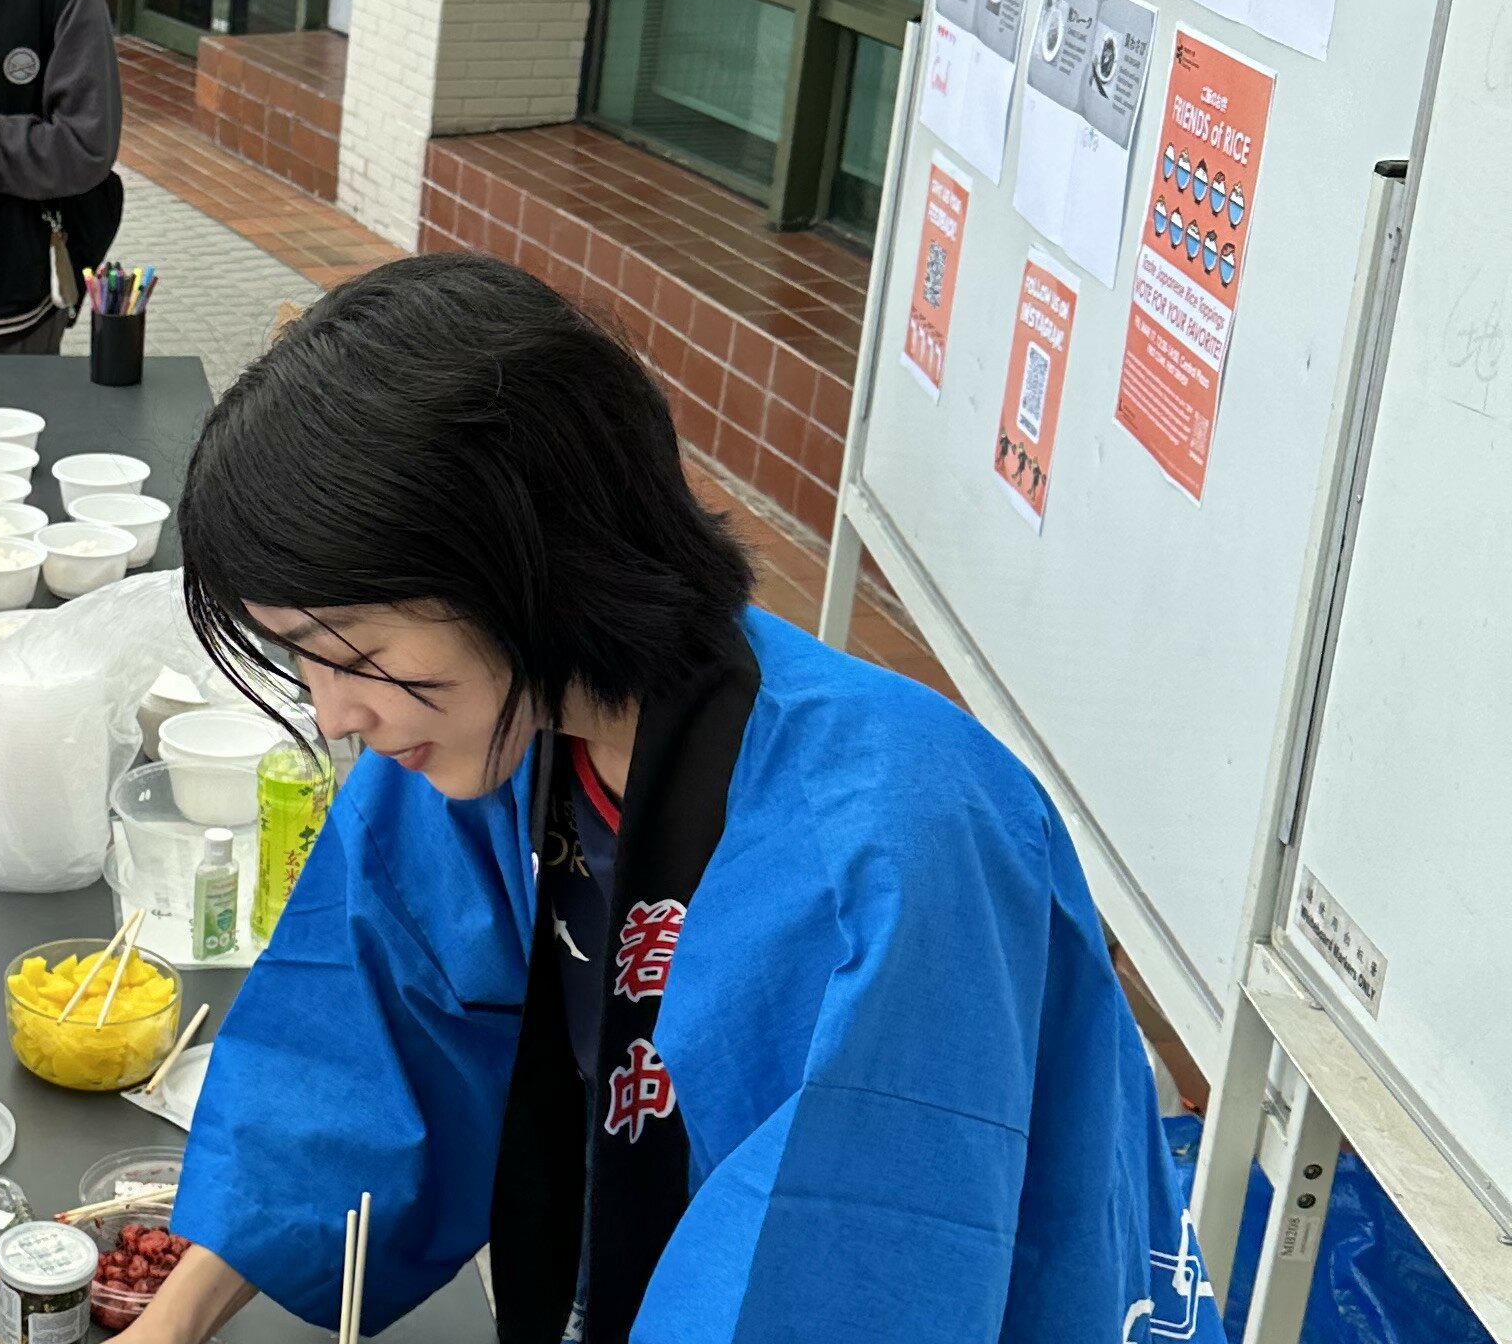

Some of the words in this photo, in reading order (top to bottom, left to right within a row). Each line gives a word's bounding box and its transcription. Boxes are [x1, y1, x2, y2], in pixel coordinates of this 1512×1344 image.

[1173, 94, 1211, 142] FRIENDS
[1210, 121, 1225, 148] of
[1222, 125, 1251, 167] RICE
[1357, 973, 1376, 1001] ONLY
